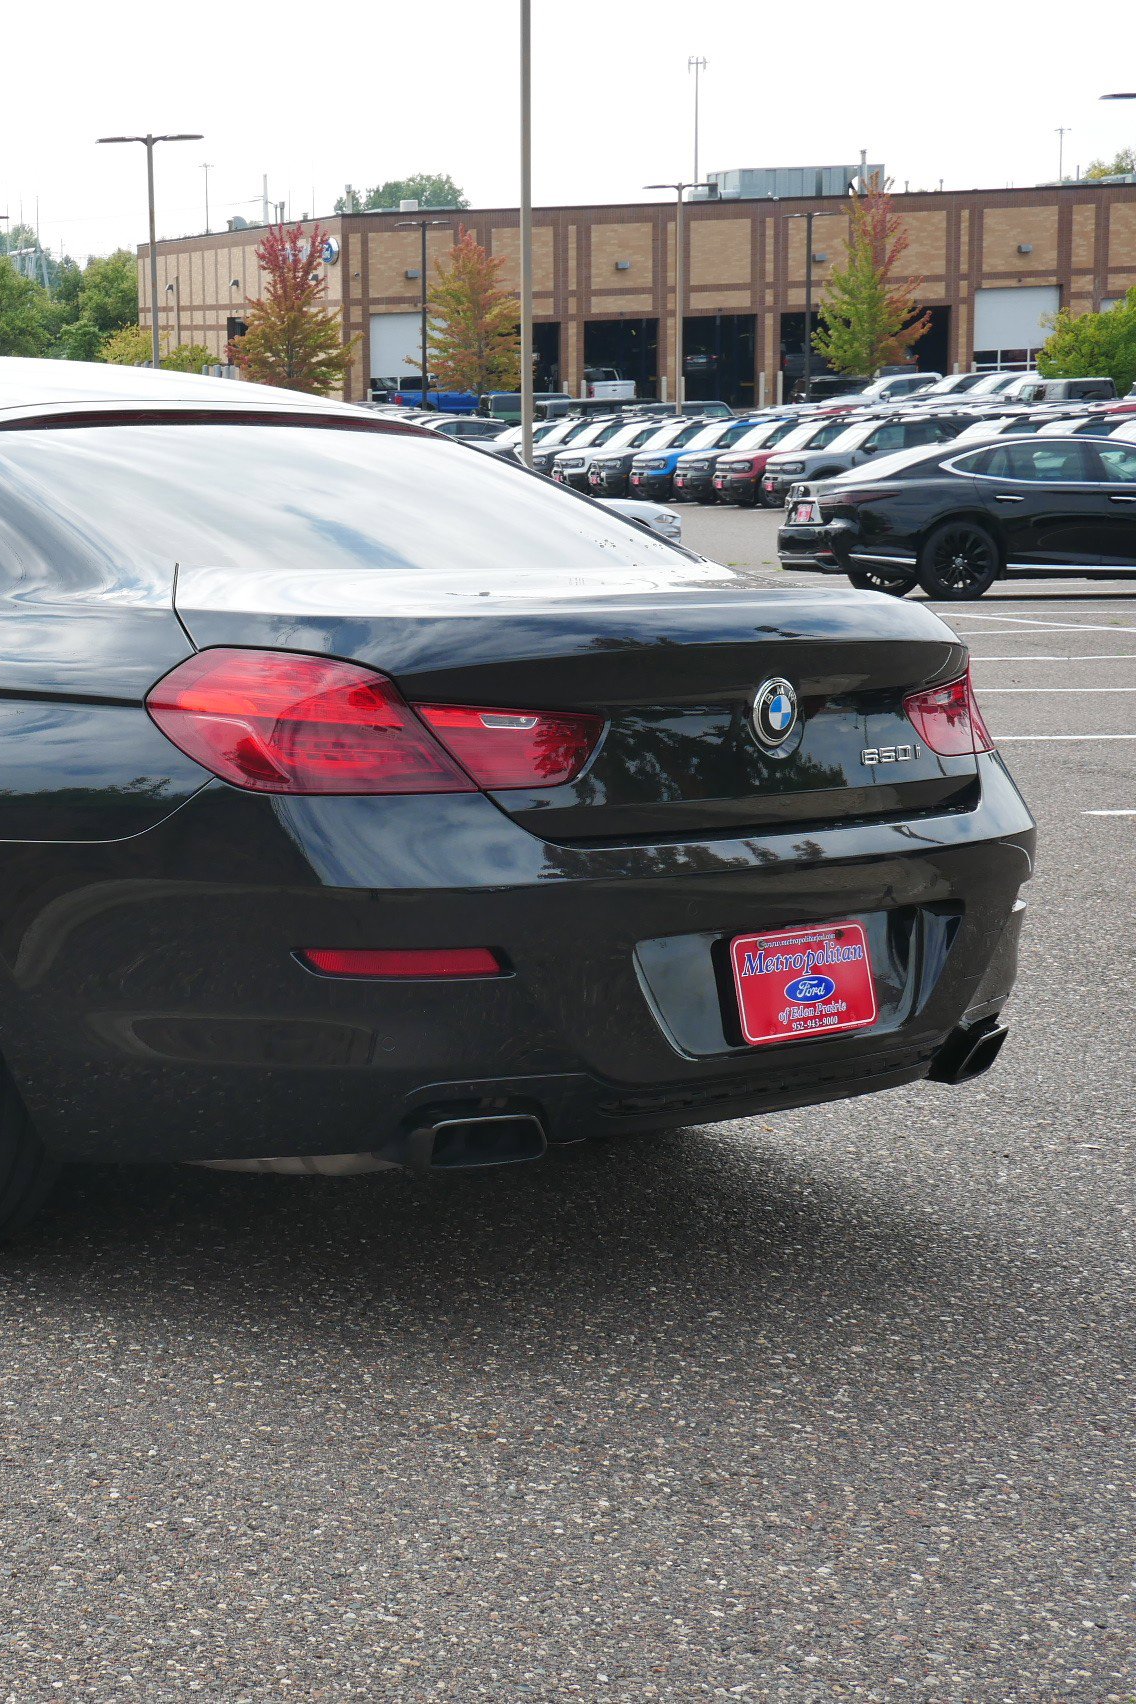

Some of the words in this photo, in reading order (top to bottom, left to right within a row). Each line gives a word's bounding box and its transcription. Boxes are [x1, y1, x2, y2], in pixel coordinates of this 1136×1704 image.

[765, 685, 797, 704] BMW
[742, 941, 863, 977] Metropolitan
[796, 980, 825, 997] Ford
[778, 1007, 790, 1025] of
[790, 1006, 815, 1020] Eden
[815, 999, 847, 1016] Prairie
[792, 1016, 838, 1031] 952-943-9000
